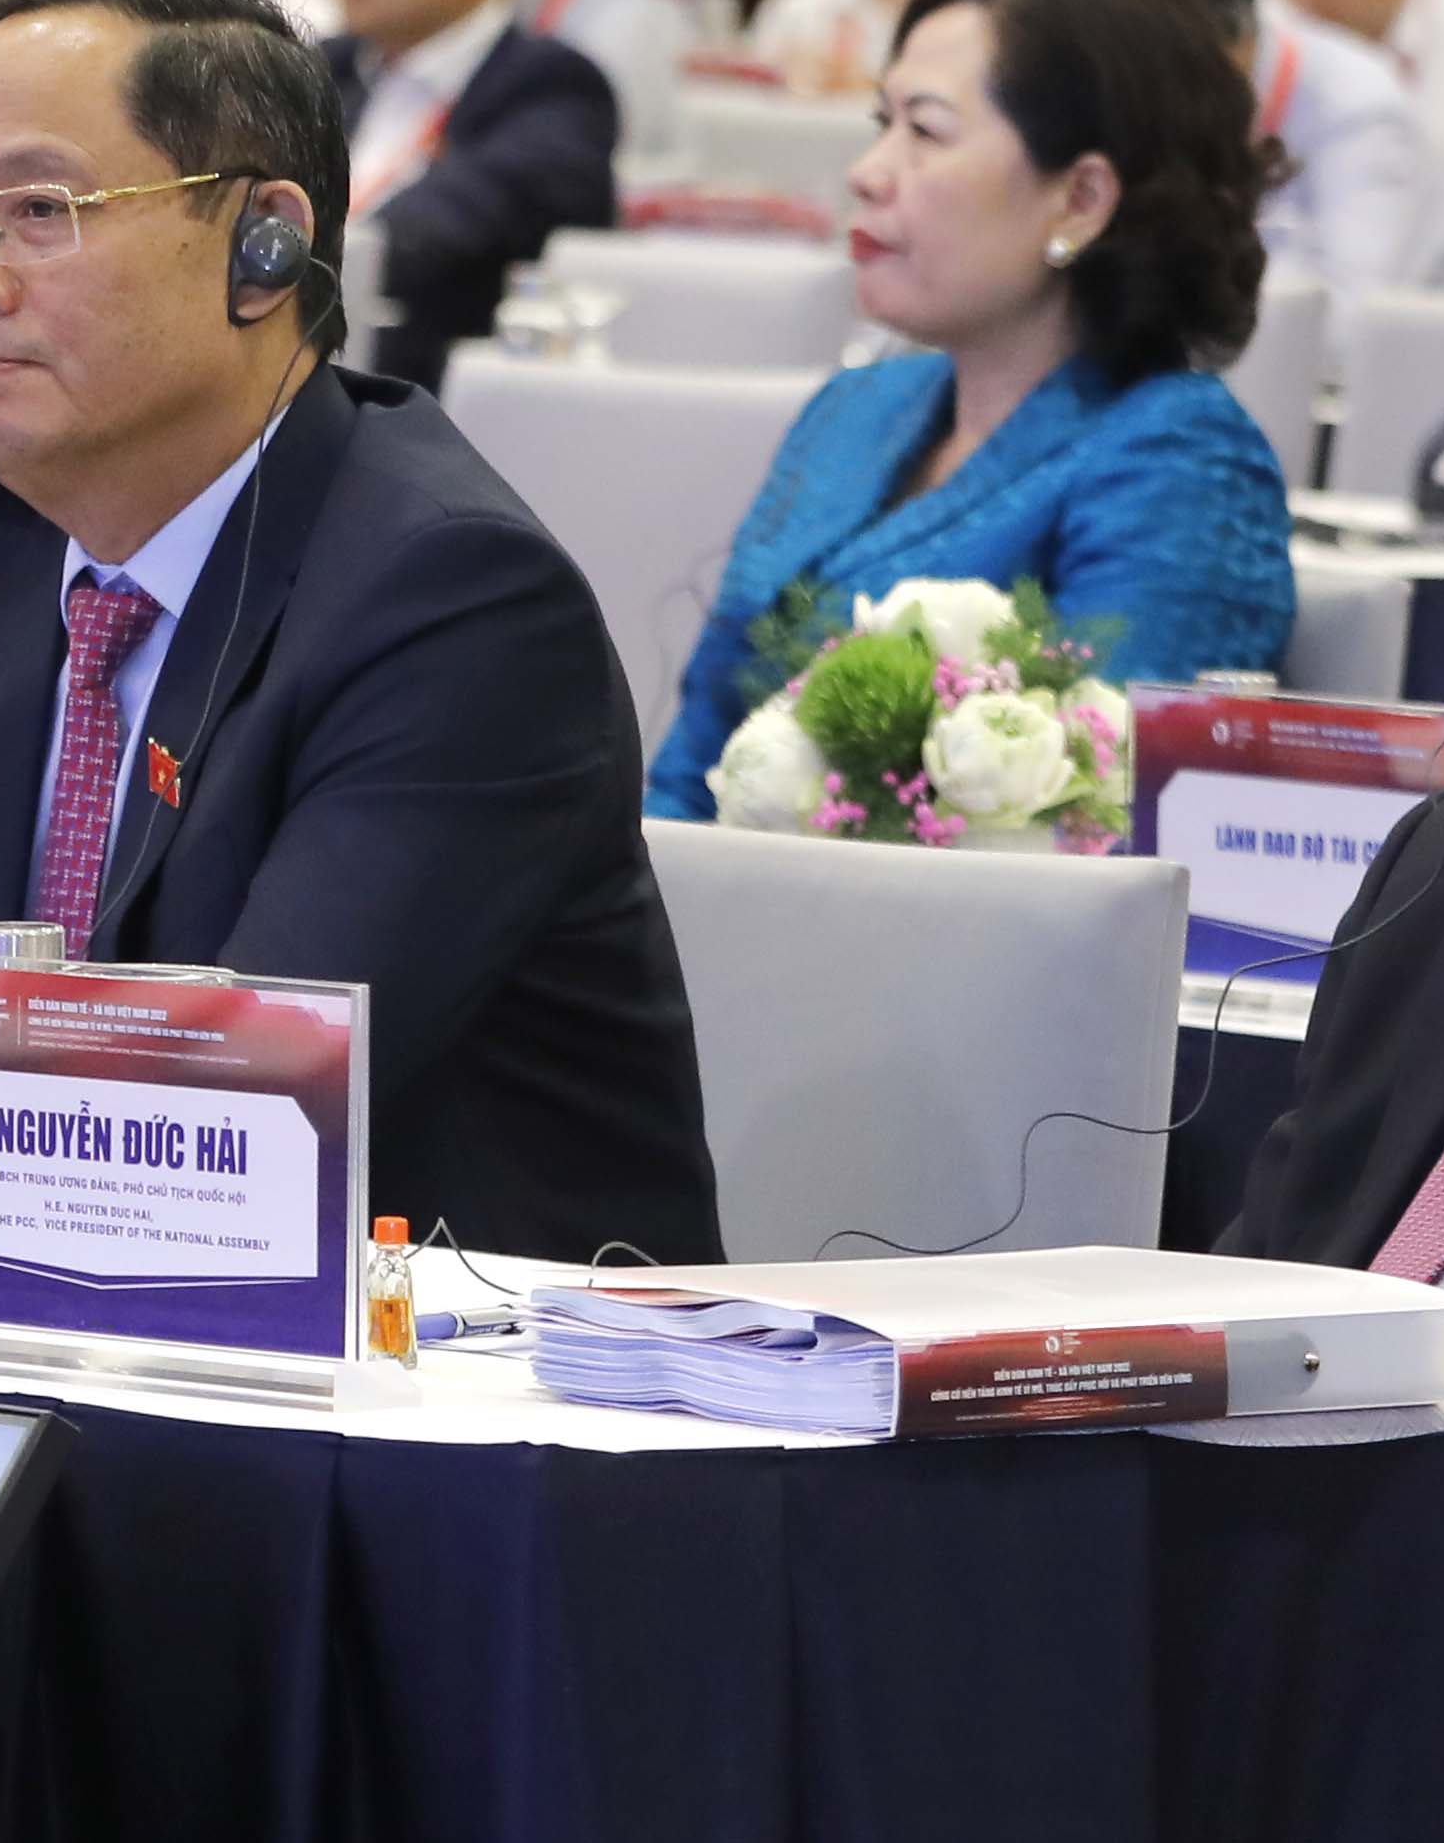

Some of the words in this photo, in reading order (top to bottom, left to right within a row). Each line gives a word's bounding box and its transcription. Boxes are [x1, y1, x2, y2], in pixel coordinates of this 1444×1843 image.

[123, 1114, 184, 1170] ĐỨC
[197, 1117, 247, 1175] HẢI
[0, 1171, 19, 1183] BCH
[24, 1173, 56, 1186] TRUNG
[123, 1180, 144, 1194] PHÓ
[147, 1183, 167, 1197] CHỦ
[171, 1187, 193, 1200] TỊCH
[197, 1186, 224, 1202] QUỐC
[228, 1191, 246, 1205] HỘI
[44, 1201, 64, 1213] H.E.
[68, 1203, 107, 1218] NGUYEN
[110, 1206, 131, 1219] DUC
[134, 1208, 153, 1222] HAI,
[15, 1216, 38, 1230] PCC,
[45, 1219, 67, 1232] VICE
[70, 1221, 124, 1237] PRESIDENT
[127, 1226, 140, 1238] OF
[143, 1227, 161, 1240] THE
[165, 1229, 214, 1246] NATIONAL
[218, 1234, 270, 1251] ASSEMBLY
